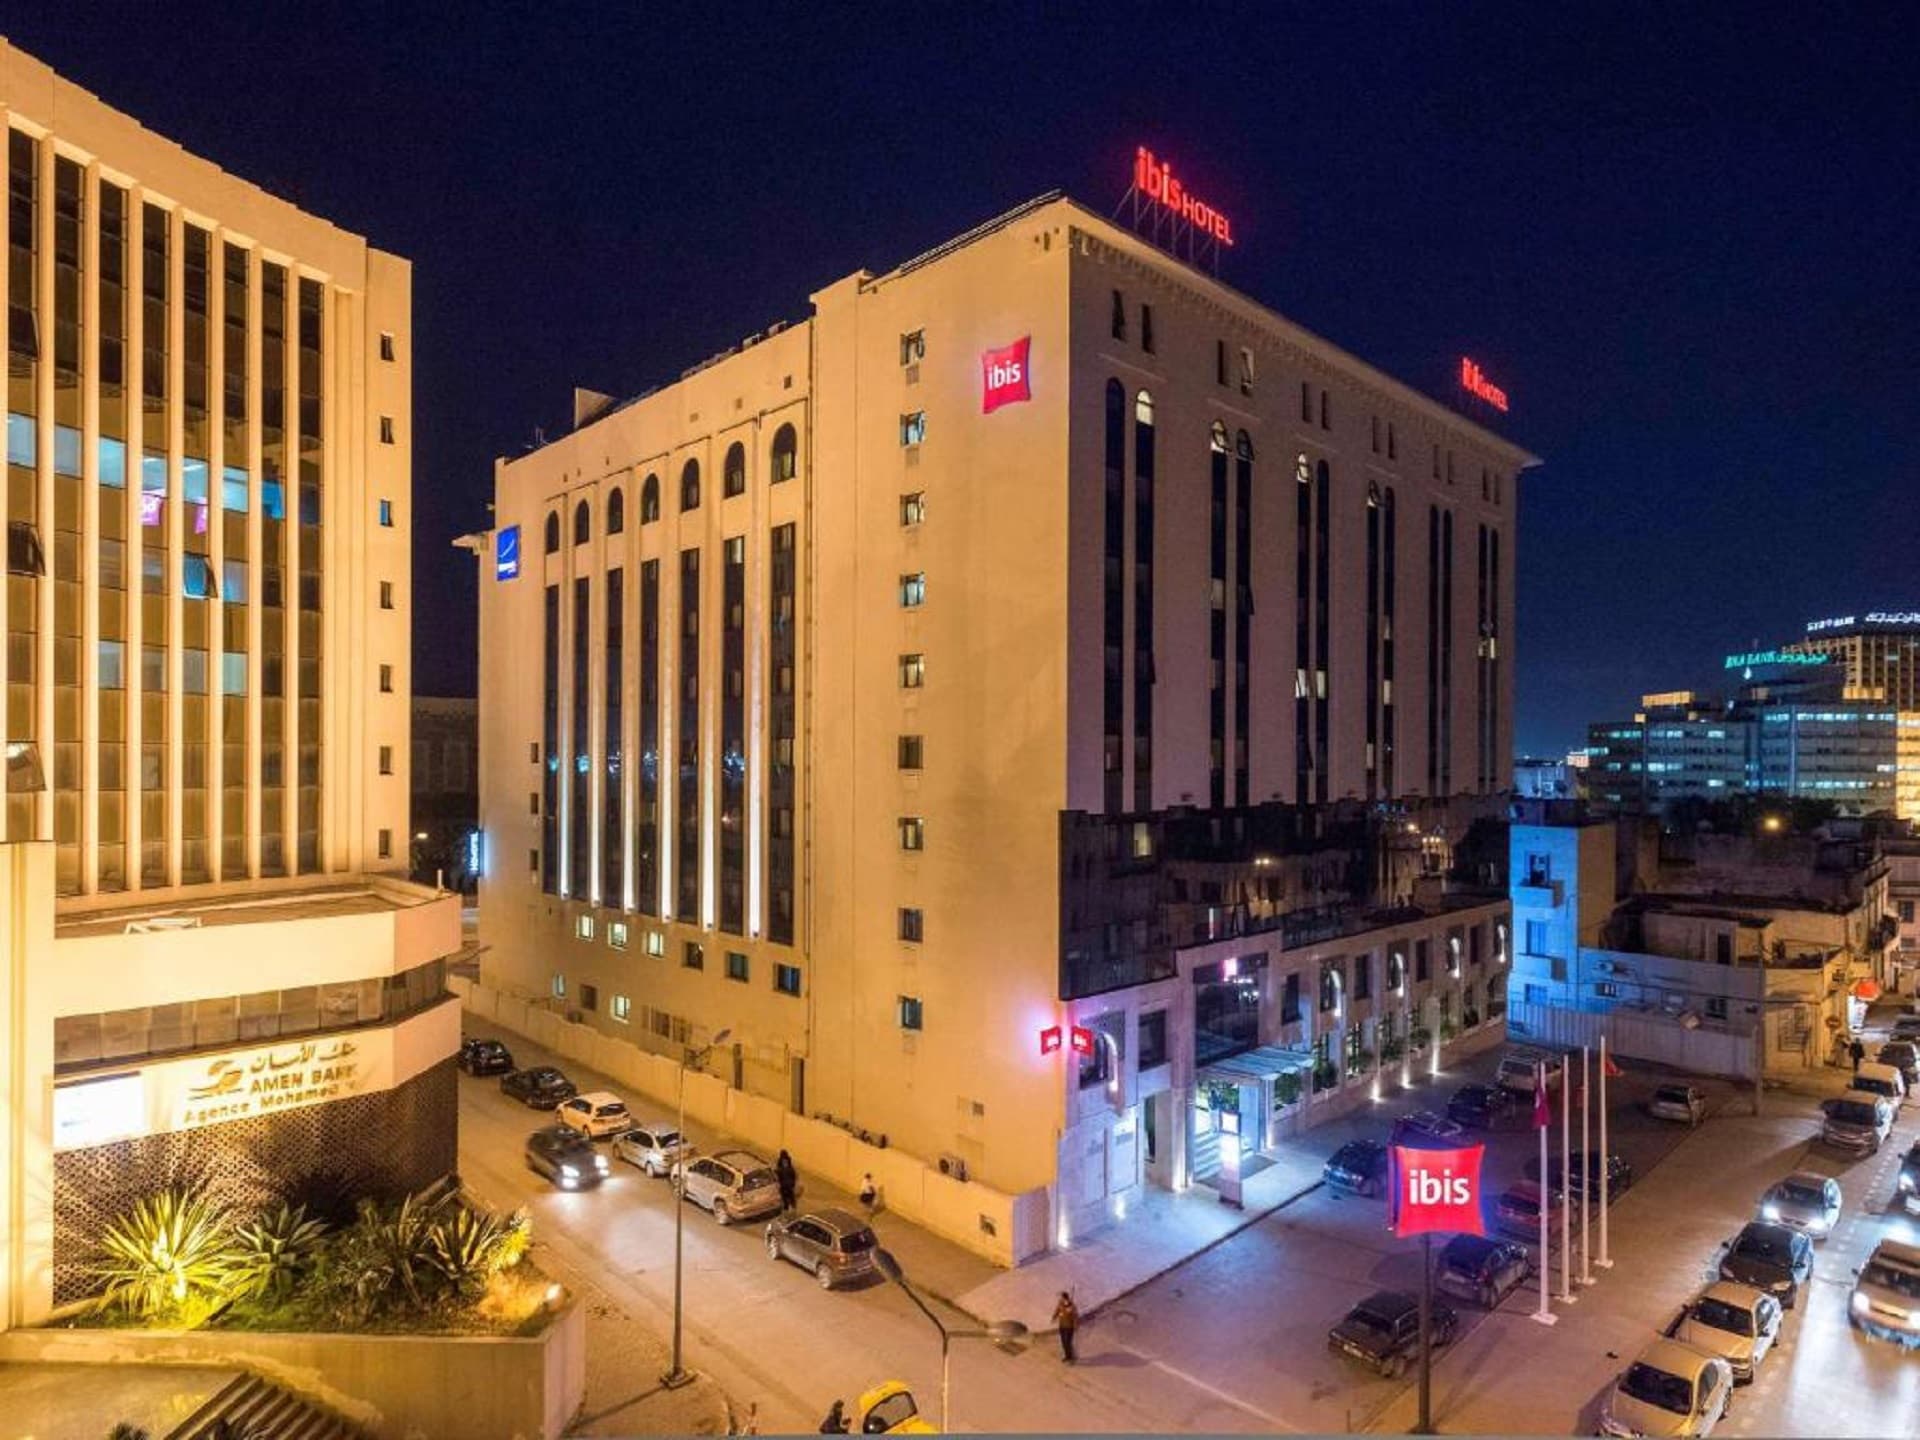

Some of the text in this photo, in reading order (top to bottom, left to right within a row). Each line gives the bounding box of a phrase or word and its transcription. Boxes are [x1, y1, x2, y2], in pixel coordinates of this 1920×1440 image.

[1136, 146, 1234, 246] ibis HOTEL
[987, 360, 1021, 390] ibis
[250, 1073, 303, 1094] AMEN
[260, 1084, 339, 1108] Mohamed
[1409, 1168, 1470, 1205] ibis
